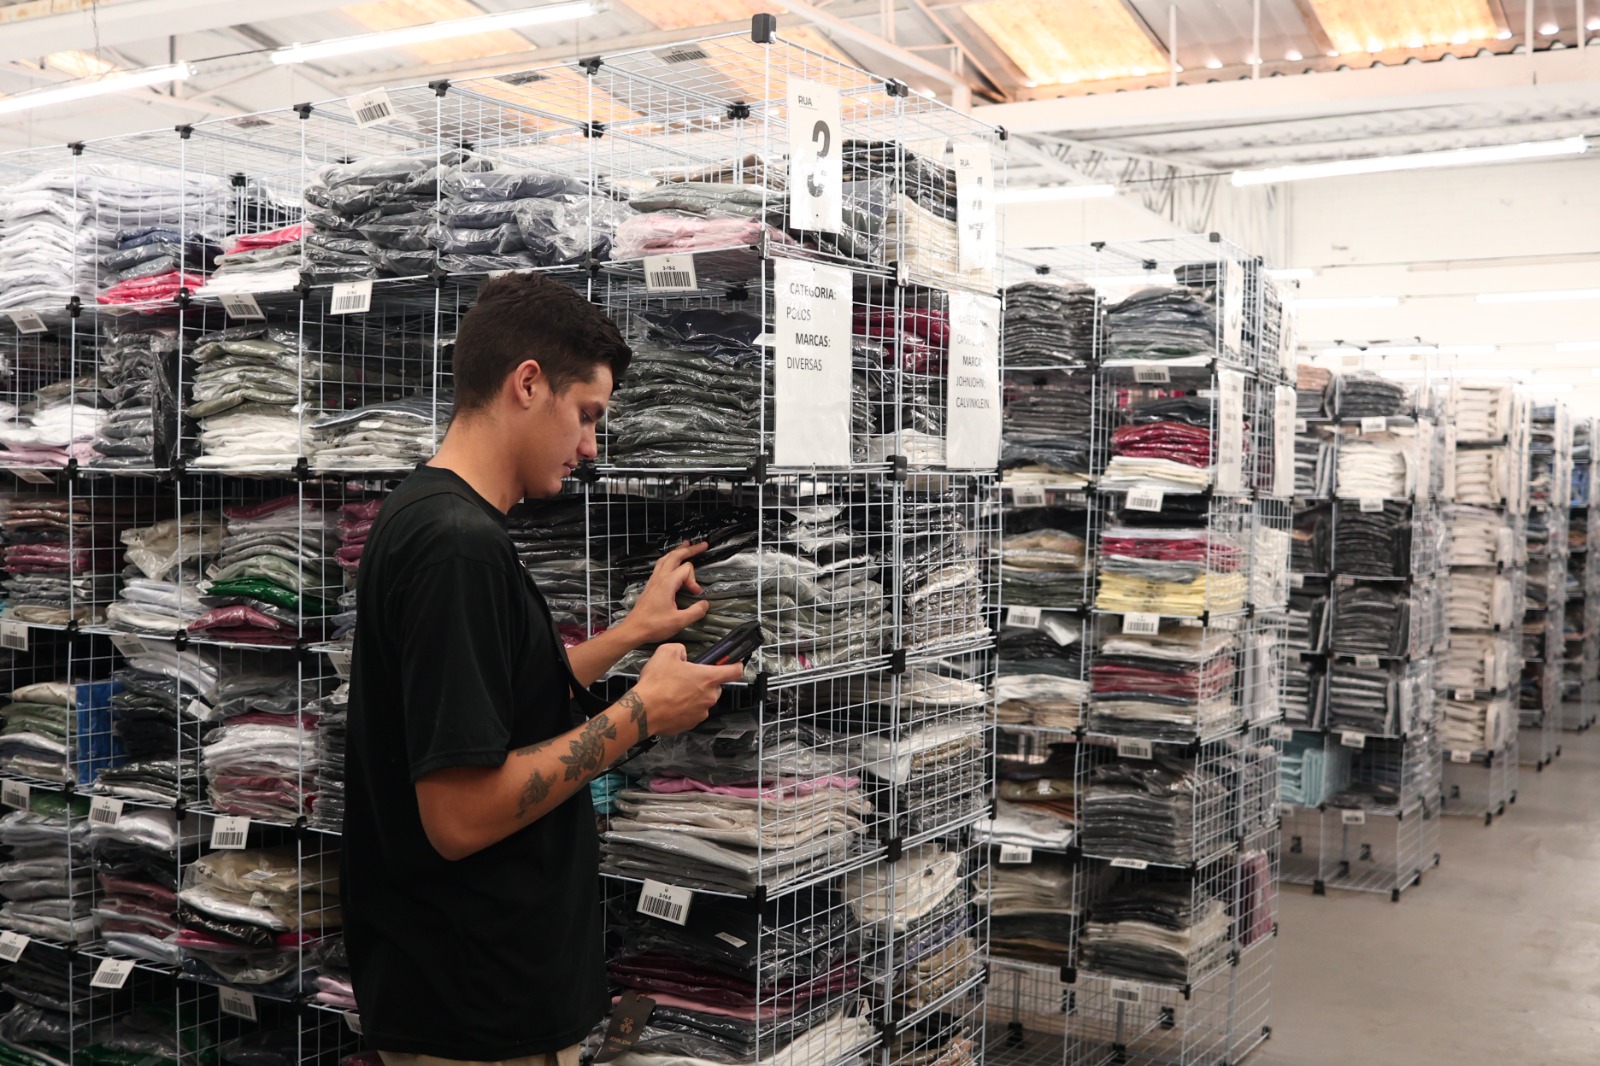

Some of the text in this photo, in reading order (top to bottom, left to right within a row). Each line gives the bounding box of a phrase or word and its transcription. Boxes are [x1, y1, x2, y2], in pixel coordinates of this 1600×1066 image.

[798, 95, 813, 106] RUA
[807, 120, 830, 197] 3
[790, 282, 836, 300] CATEGORIA:
[795, 333, 831, 348] MARCAS:
[786, 356, 822, 371] DIVERSAS
